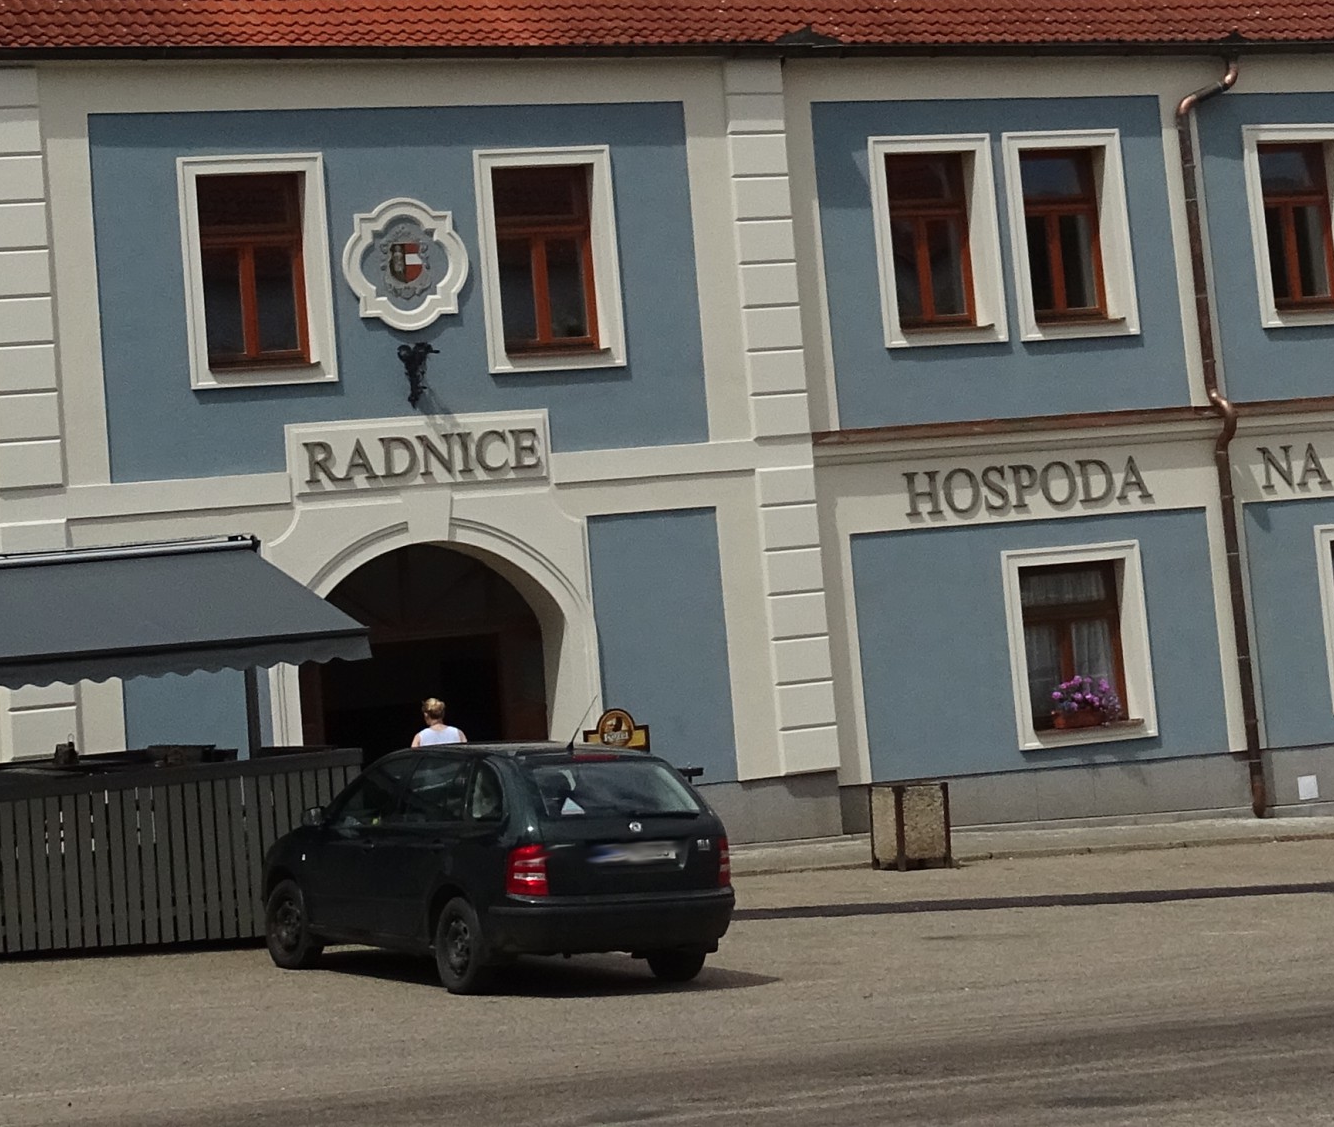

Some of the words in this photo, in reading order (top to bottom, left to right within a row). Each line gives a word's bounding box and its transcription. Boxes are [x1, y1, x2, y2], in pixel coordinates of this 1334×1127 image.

[302, 428, 542, 483] RADNICE
[902, 455, 1154, 516] HOSPODA
[1256, 442, 1331, 492] NA
